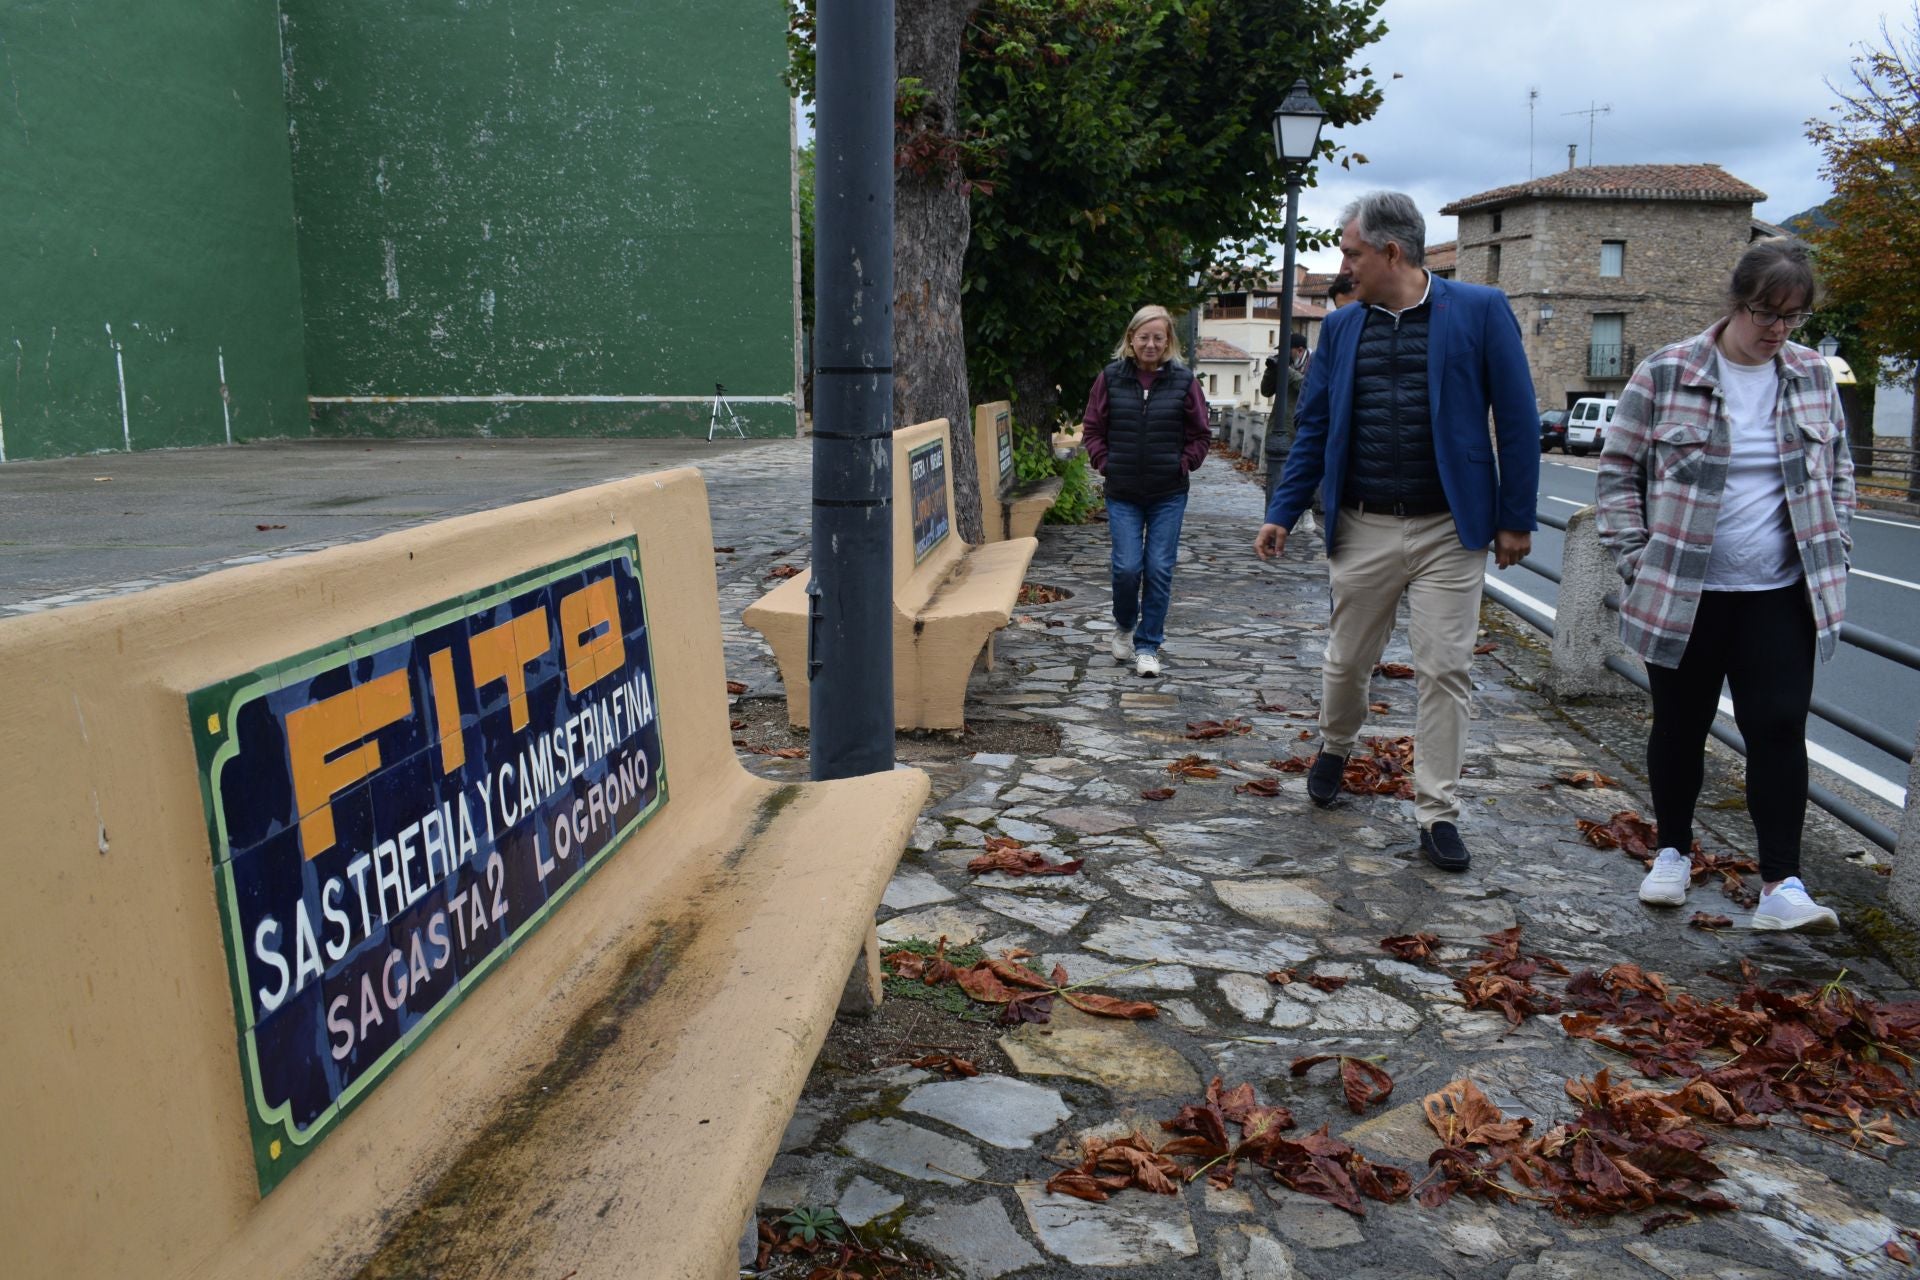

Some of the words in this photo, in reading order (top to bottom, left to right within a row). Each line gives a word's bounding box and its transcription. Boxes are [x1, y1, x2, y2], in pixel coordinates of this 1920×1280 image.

[255, 791, 477, 1011] SASTRERIA
[477, 773, 494, 843] Y
[499, 698, 615, 827] CAMISERIA
[612, 672, 653, 743] FINA
[285, 576, 624, 861] FITO
[533, 749, 649, 882] LOGROÑO
